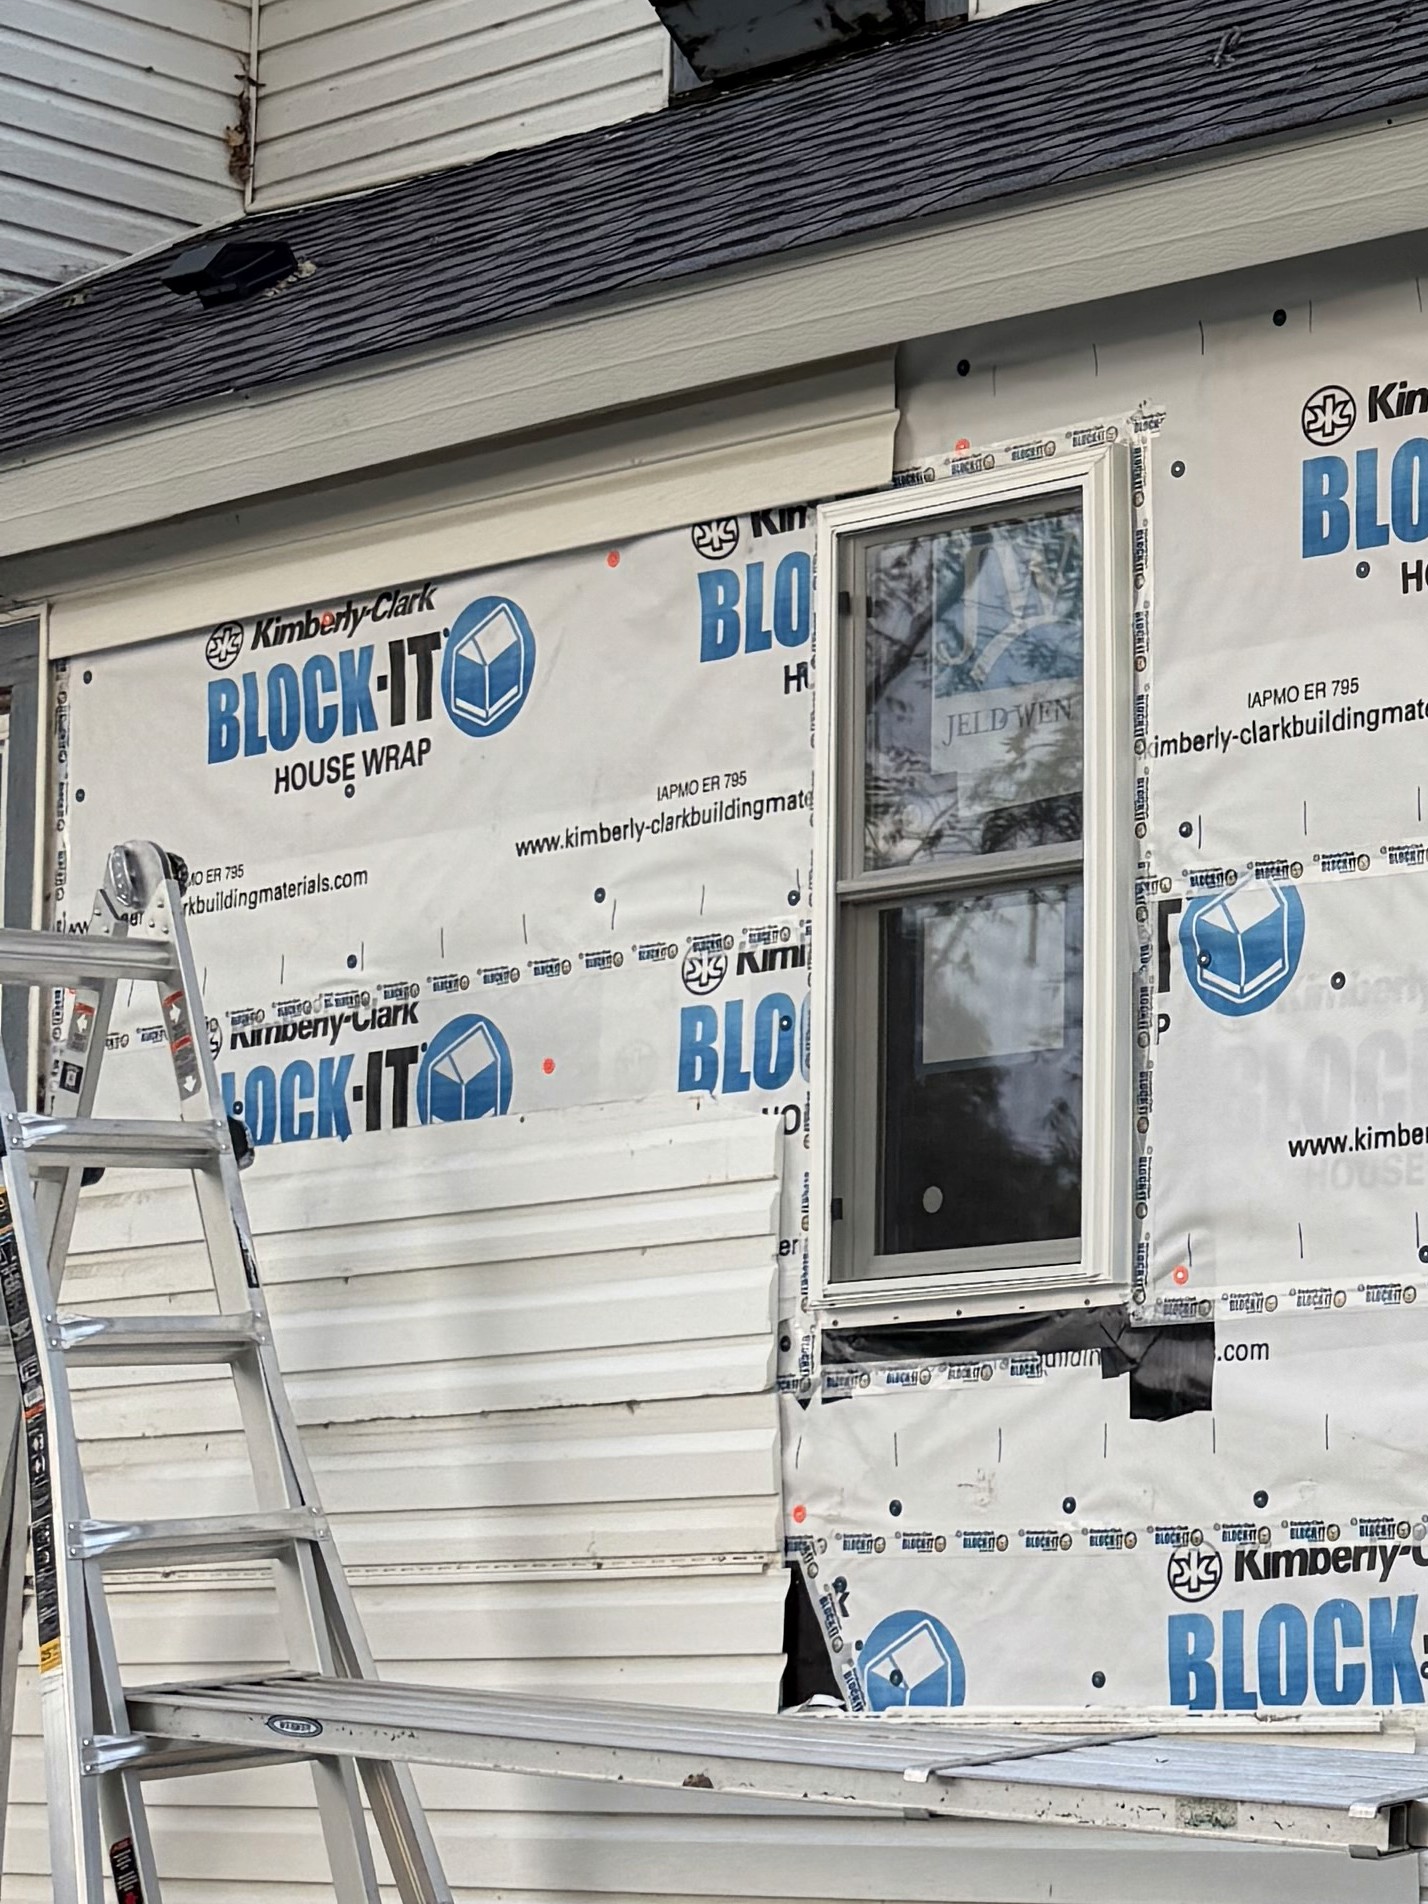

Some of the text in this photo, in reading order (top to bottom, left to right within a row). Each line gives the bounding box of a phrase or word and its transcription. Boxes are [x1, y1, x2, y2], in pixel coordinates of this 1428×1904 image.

[250, 582, 438, 651] Kimberly-Clark
[207, 632, 441, 764] BLOCK-IT
[1247, 677, 1359, 709] IAPMO ER 795
[274, 739, 432, 794] HOUSE WRAP
[657, 771, 747, 801] IAPMO ER 795
[206, 867, 222, 883] ER
[225, 864, 244, 880] 795
